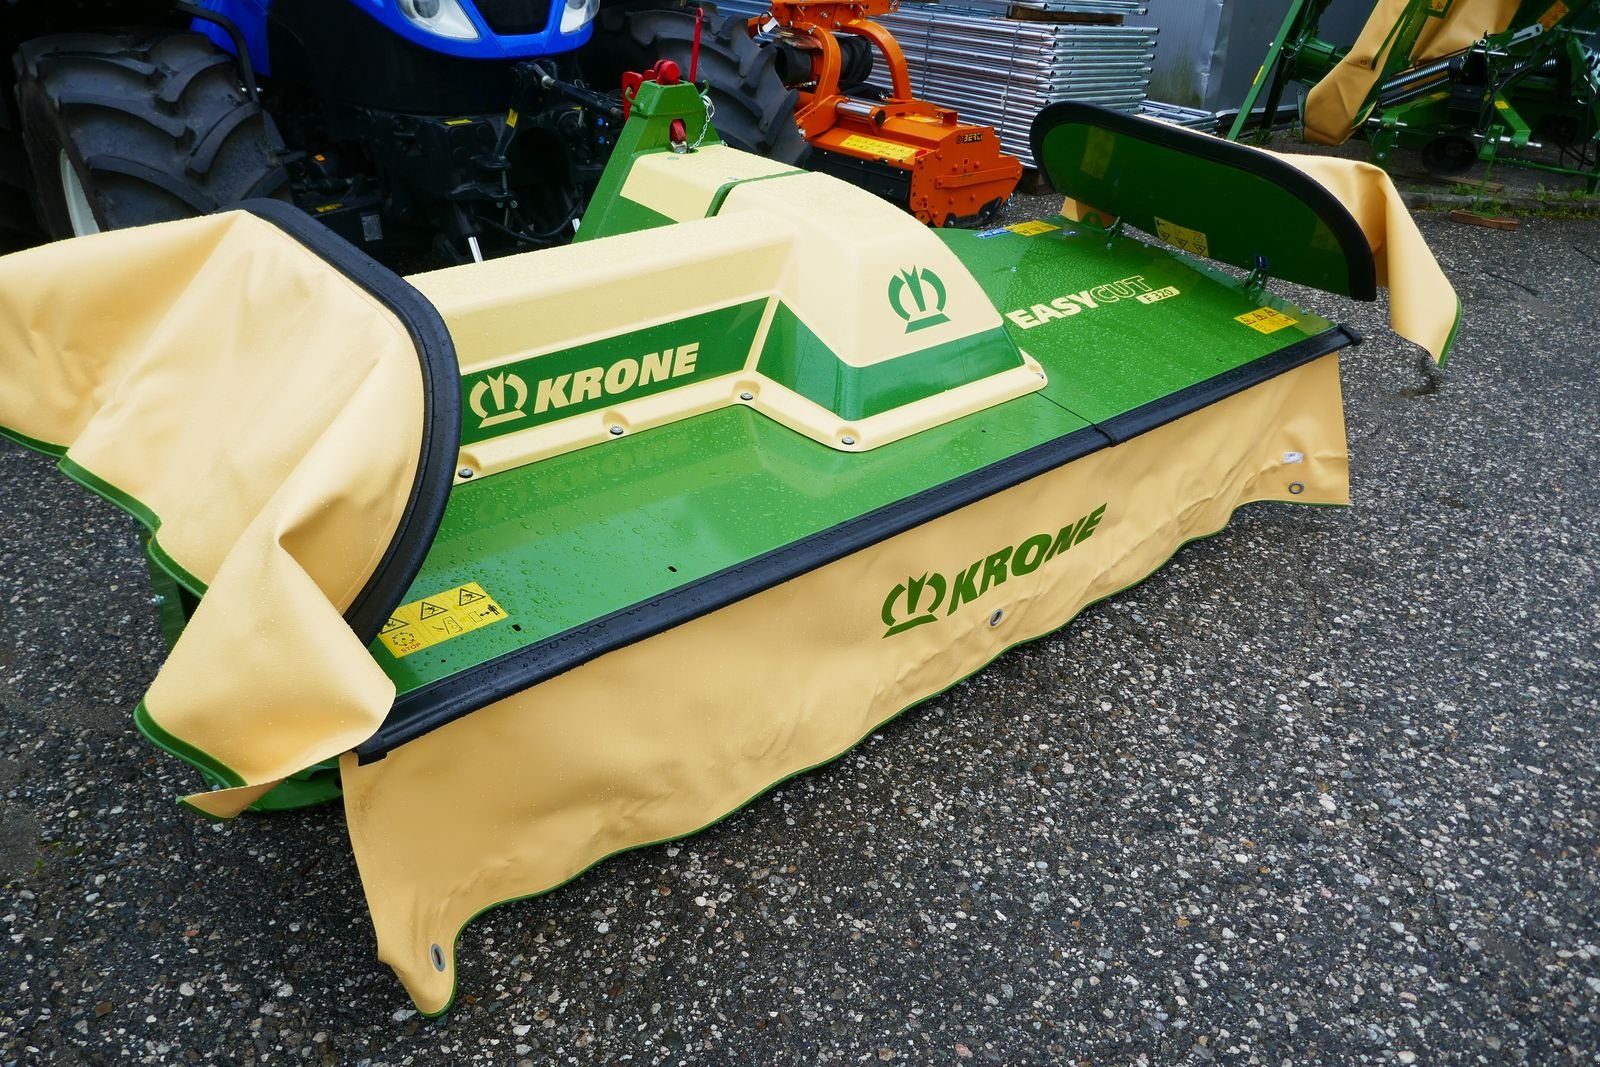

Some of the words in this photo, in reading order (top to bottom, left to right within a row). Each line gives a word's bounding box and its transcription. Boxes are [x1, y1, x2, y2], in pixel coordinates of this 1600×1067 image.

[1152, 288, 1174, 300] 320
[534, 342, 699, 414] KRONE
[947, 502, 1107, 616] KRONE
[400, 642, 421, 653] STOP
